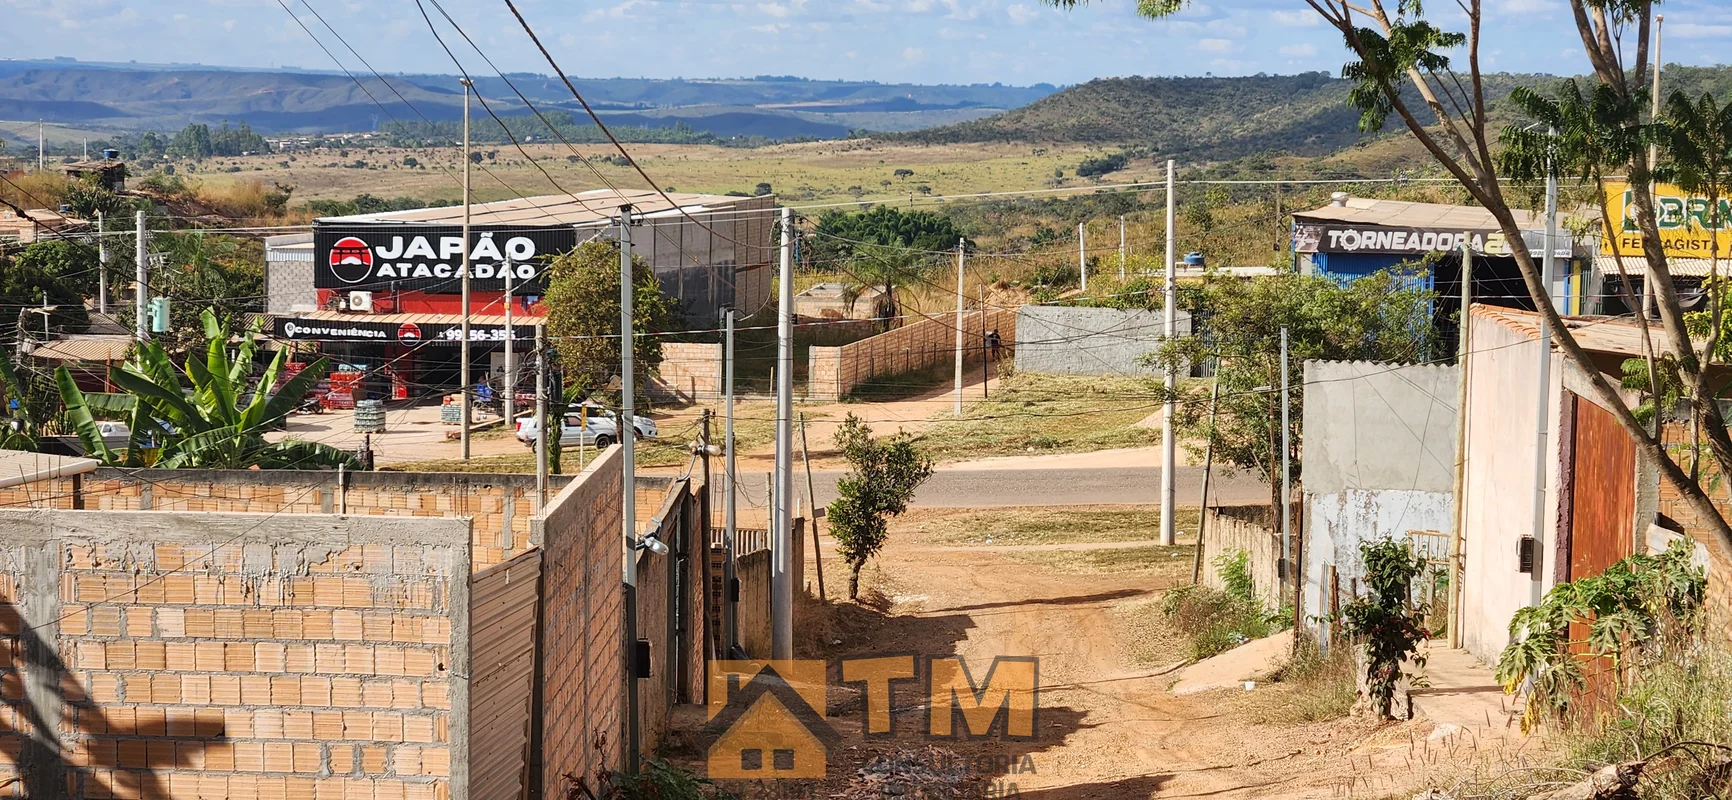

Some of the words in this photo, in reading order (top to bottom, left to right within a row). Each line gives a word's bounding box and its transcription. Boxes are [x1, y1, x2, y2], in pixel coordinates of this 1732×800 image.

[375, 231, 536, 261] JAPÃO
[1622, 237, 1720, 251] FEAGIST
[295, 326, 387, 338] CONVENIÊNCIA
